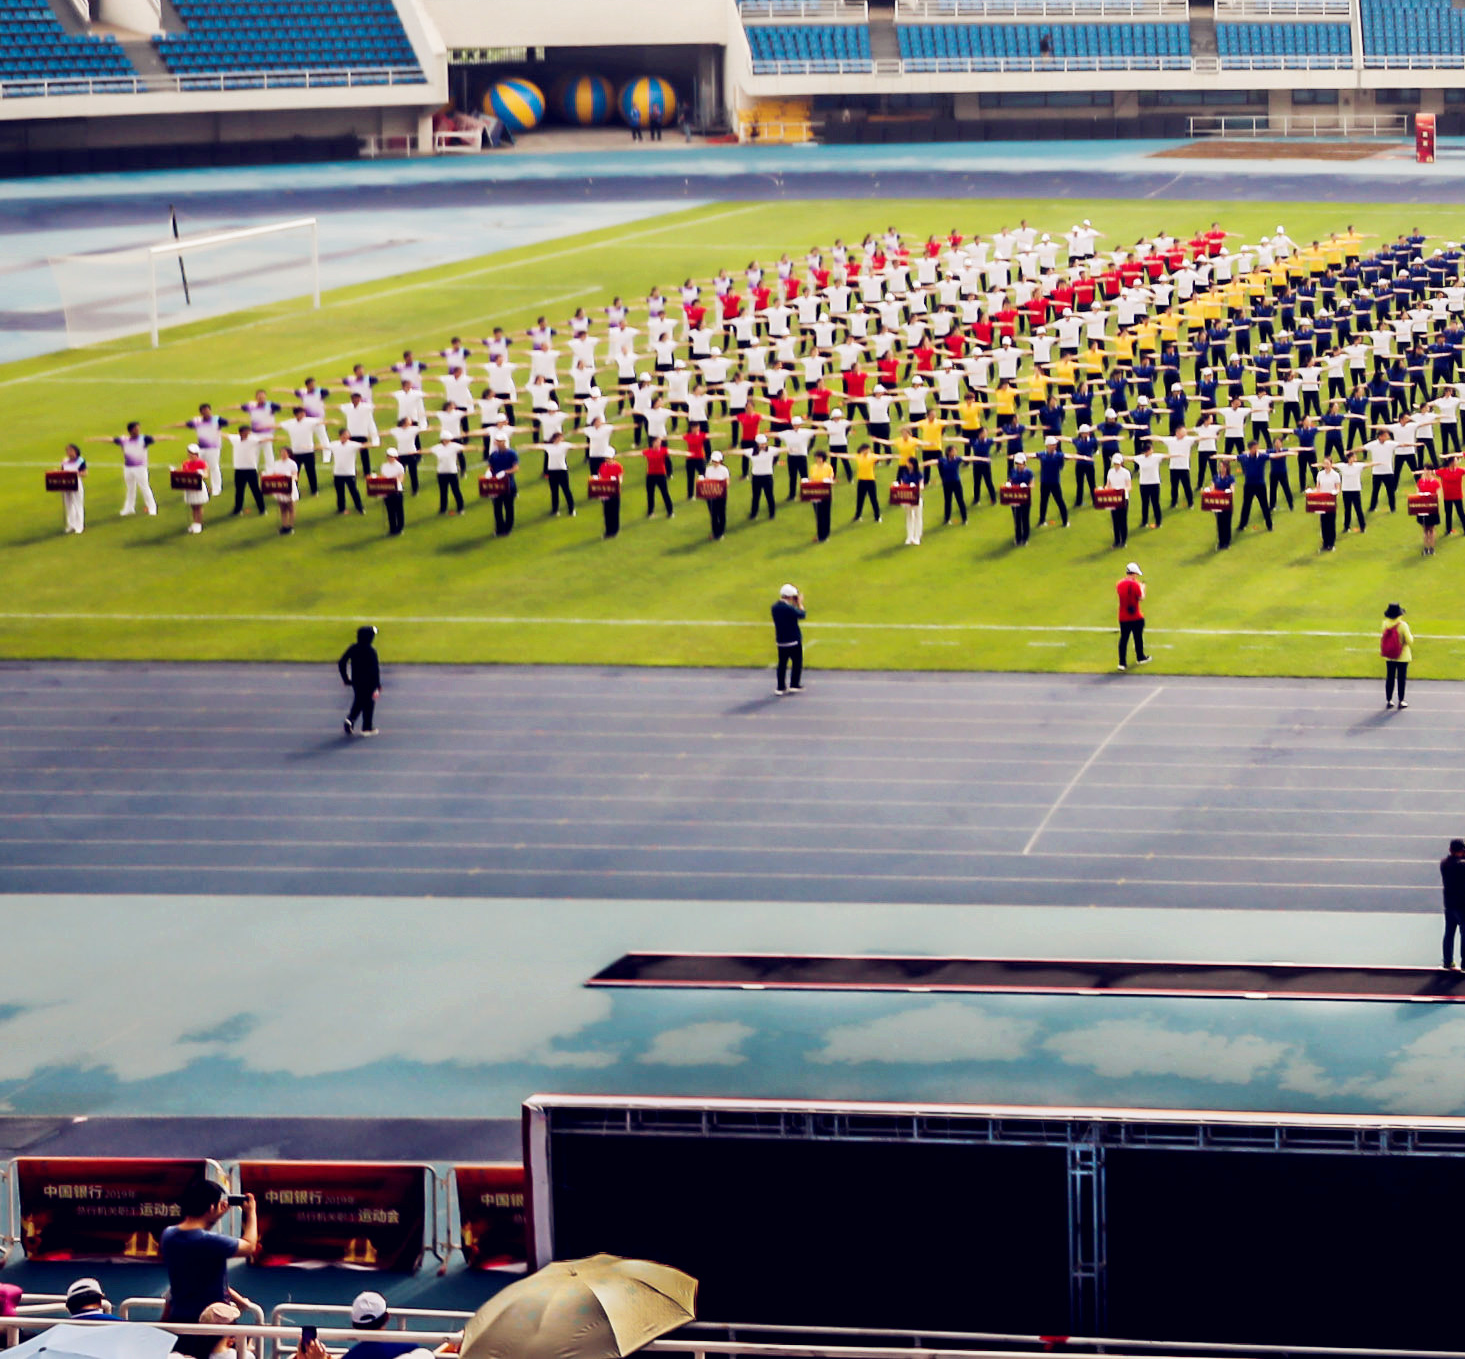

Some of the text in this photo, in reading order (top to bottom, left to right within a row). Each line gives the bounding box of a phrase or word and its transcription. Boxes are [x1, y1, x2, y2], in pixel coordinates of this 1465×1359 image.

[43, 1184, 102, 1199] 中国银行
[265, 1190, 323, 1205] 中国银行
[139, 1202, 182, 1217] 运动会
[358, 1208, 400, 1224] 运动会
